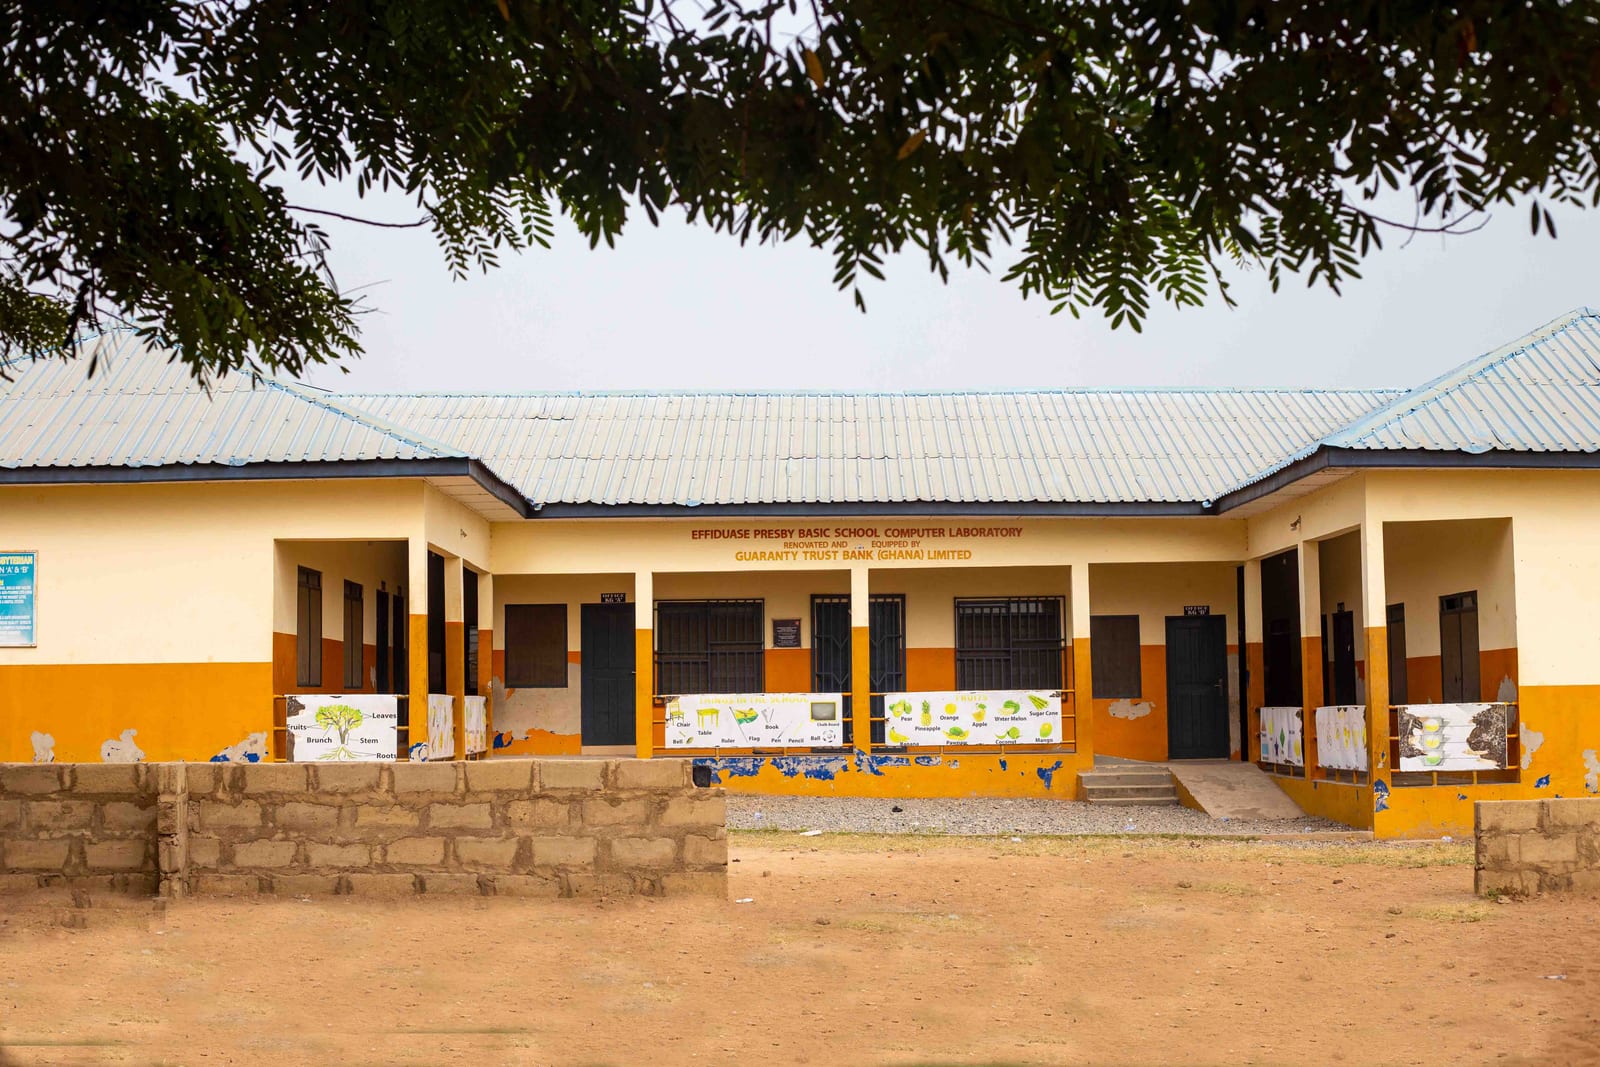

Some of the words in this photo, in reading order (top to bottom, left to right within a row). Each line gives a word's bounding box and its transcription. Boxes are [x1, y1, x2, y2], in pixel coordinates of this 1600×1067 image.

[691, 529, 750, 539] EFFIDUASE
[754, 529, 794, 539] PRESBY
[798, 528, 830, 538] BASIC
[834, 528, 880, 538] SCHOOL
[884, 528, 946, 538] COMPUTER
[949, 527, 1022, 538] LABORATORY
[784, 541, 828, 549] RENOVATED
[736, 551, 798, 561] GUARANTY
[803, 550, 838, 560] TRUST
[842, 550, 874, 560] BANK
[878, 550, 924, 560] (GHANA)
[928, 550, 972, 560] LIMITED
